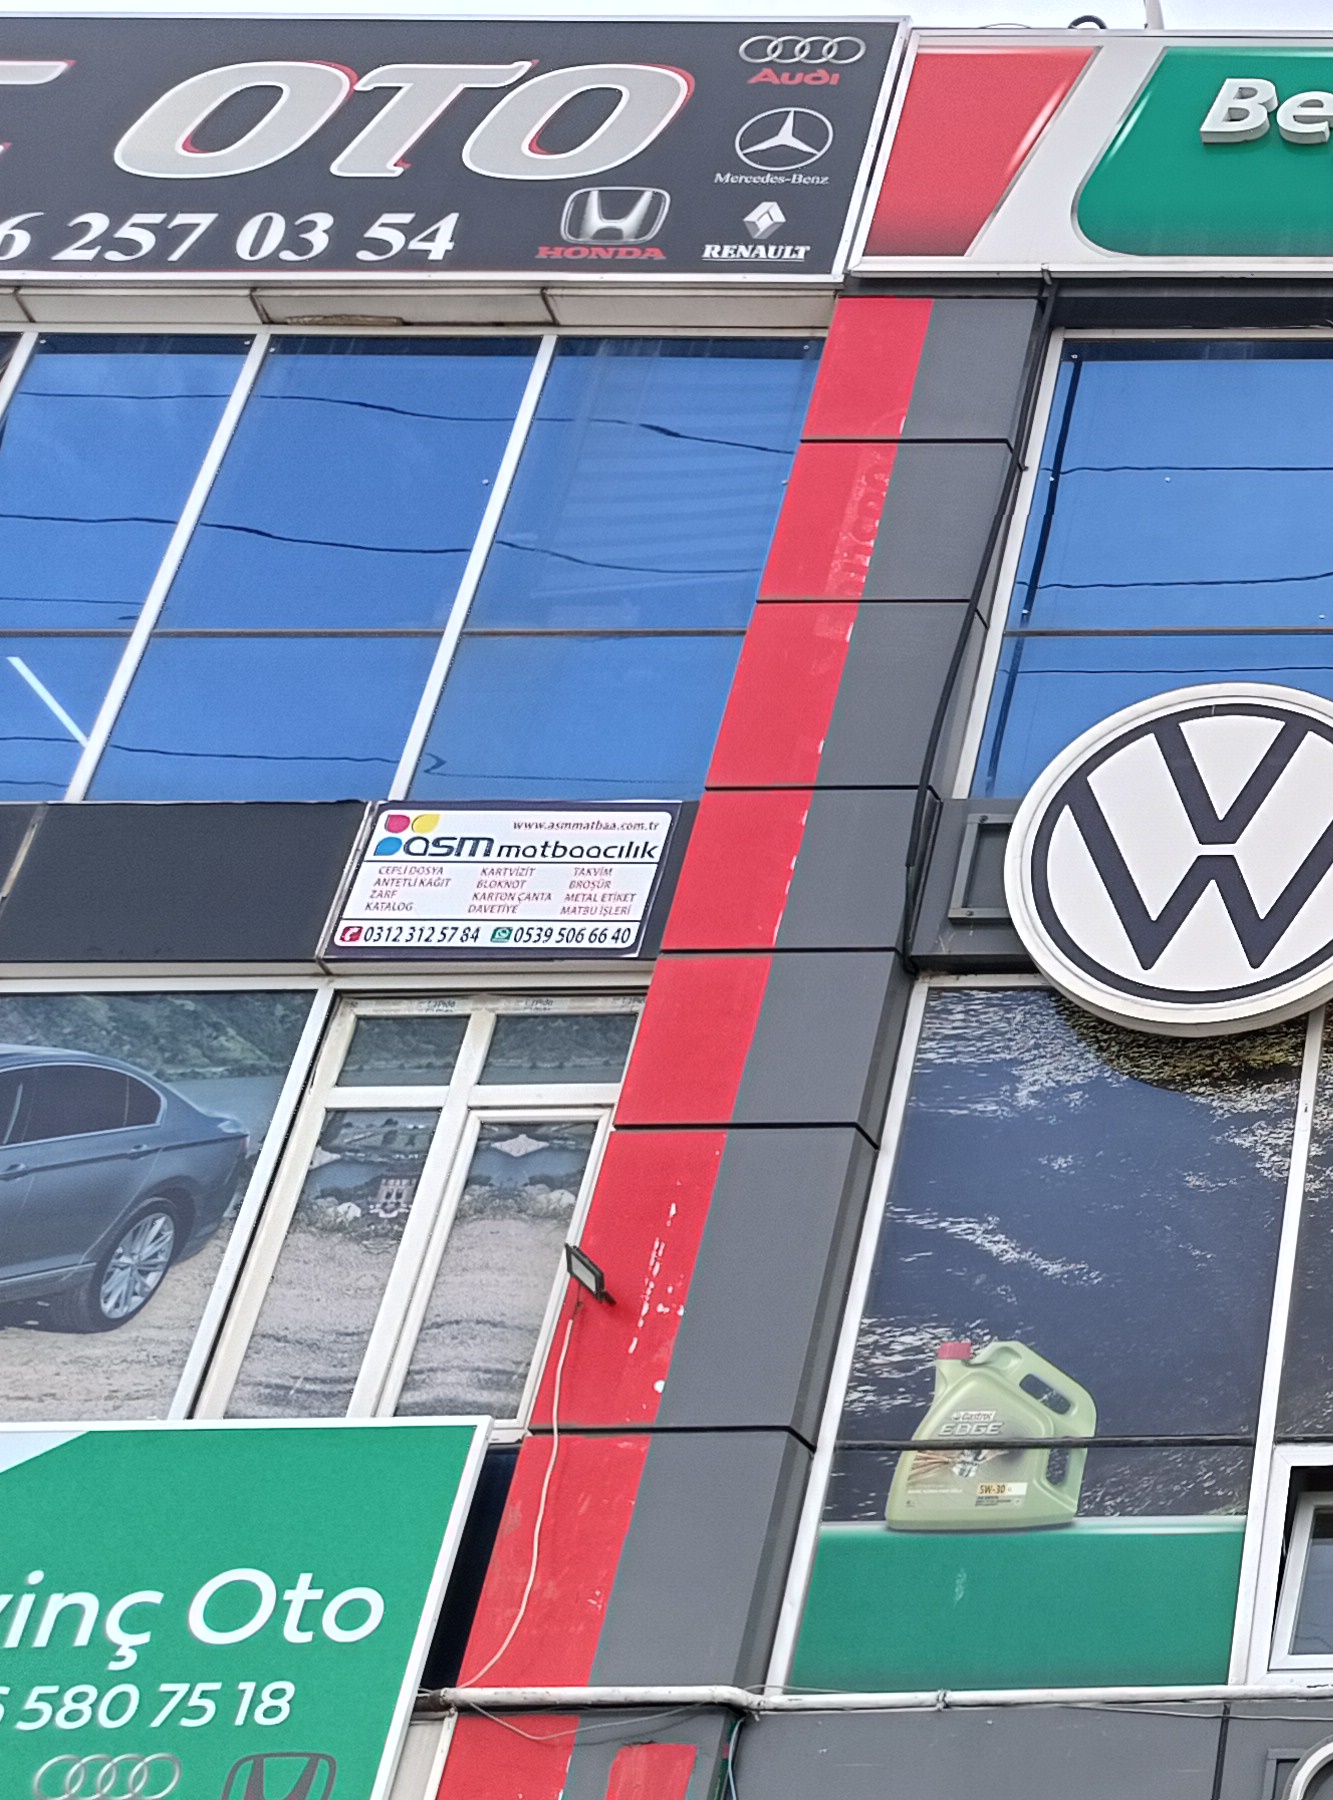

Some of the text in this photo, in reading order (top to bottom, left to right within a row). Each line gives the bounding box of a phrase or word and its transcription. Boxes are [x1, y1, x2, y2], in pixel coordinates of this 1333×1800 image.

[747, 67, 840, 86] Audi
[113, 59, 695, 180] OTO
[714, 171, 830, 185] Mercedes-Benz
[50, 211, 219, 262] 257
[235, 211, 334, 261] 03
[355, 211, 460, 261] 54
[535, 246, 667, 260] HONDA
[701, 243, 811, 261] RENAULT
[403, 835, 660, 859] asm matbaacılık
[408, 866, 444, 876] DOSYA
[476, 880, 527, 889] BLOKNOT
[370, 889, 398, 899] ZARF
[472, 892, 516, 901] KARTON
[564, 893, 598, 903] METAL
[365, 902, 414, 912] KATALOG
[559, 906, 598, 916] MATBU
[364, 926, 481, 943] 0312 312 57 84
[514, 926, 632, 944] 0539 506 66 40
[938, 1421, 1004, 1437] EDGE
[187, 1567, 385, 1645] Oto
[15, 1683, 140, 1731] 580
[149, 1681, 222, 1728] 75
[234, 1680, 296, 1726] 18
